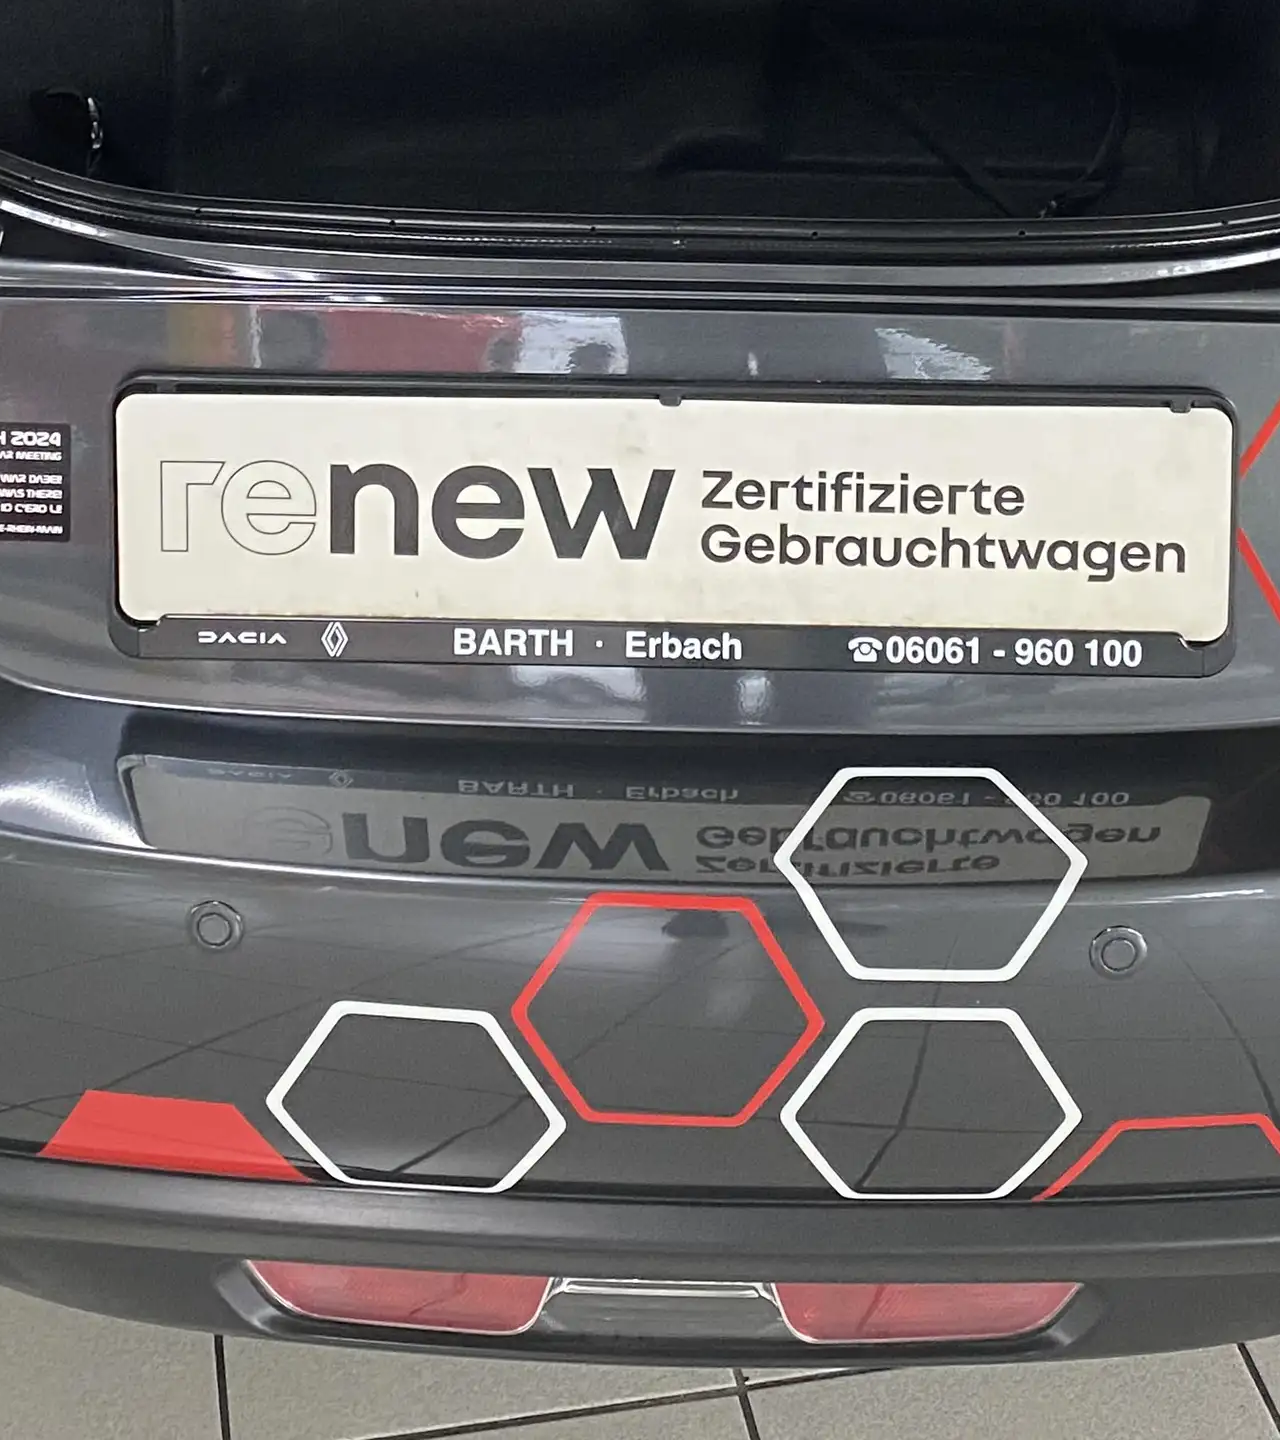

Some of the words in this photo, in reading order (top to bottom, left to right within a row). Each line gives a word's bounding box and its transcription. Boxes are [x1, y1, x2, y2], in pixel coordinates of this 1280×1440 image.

[10, 431, 62, 447] 2024
[15, 451, 62, 461] MEETING
[0, 474, 26, 484] WAR
[701, 470, 1025, 516] Zertifizierte
[158, 458, 676, 561] renew
[700, 523, 1187, 583] Gebrauchtwagen
[197, 630, 288, 645] DACIA
[452, 628, 574, 658] BARTH
[624, 630, 743, 661] Erbach
[885, 636, 981, 665] 06061
[1015, 638, 1074, 667] 960
[1084, 639, 1143, 668] 100
